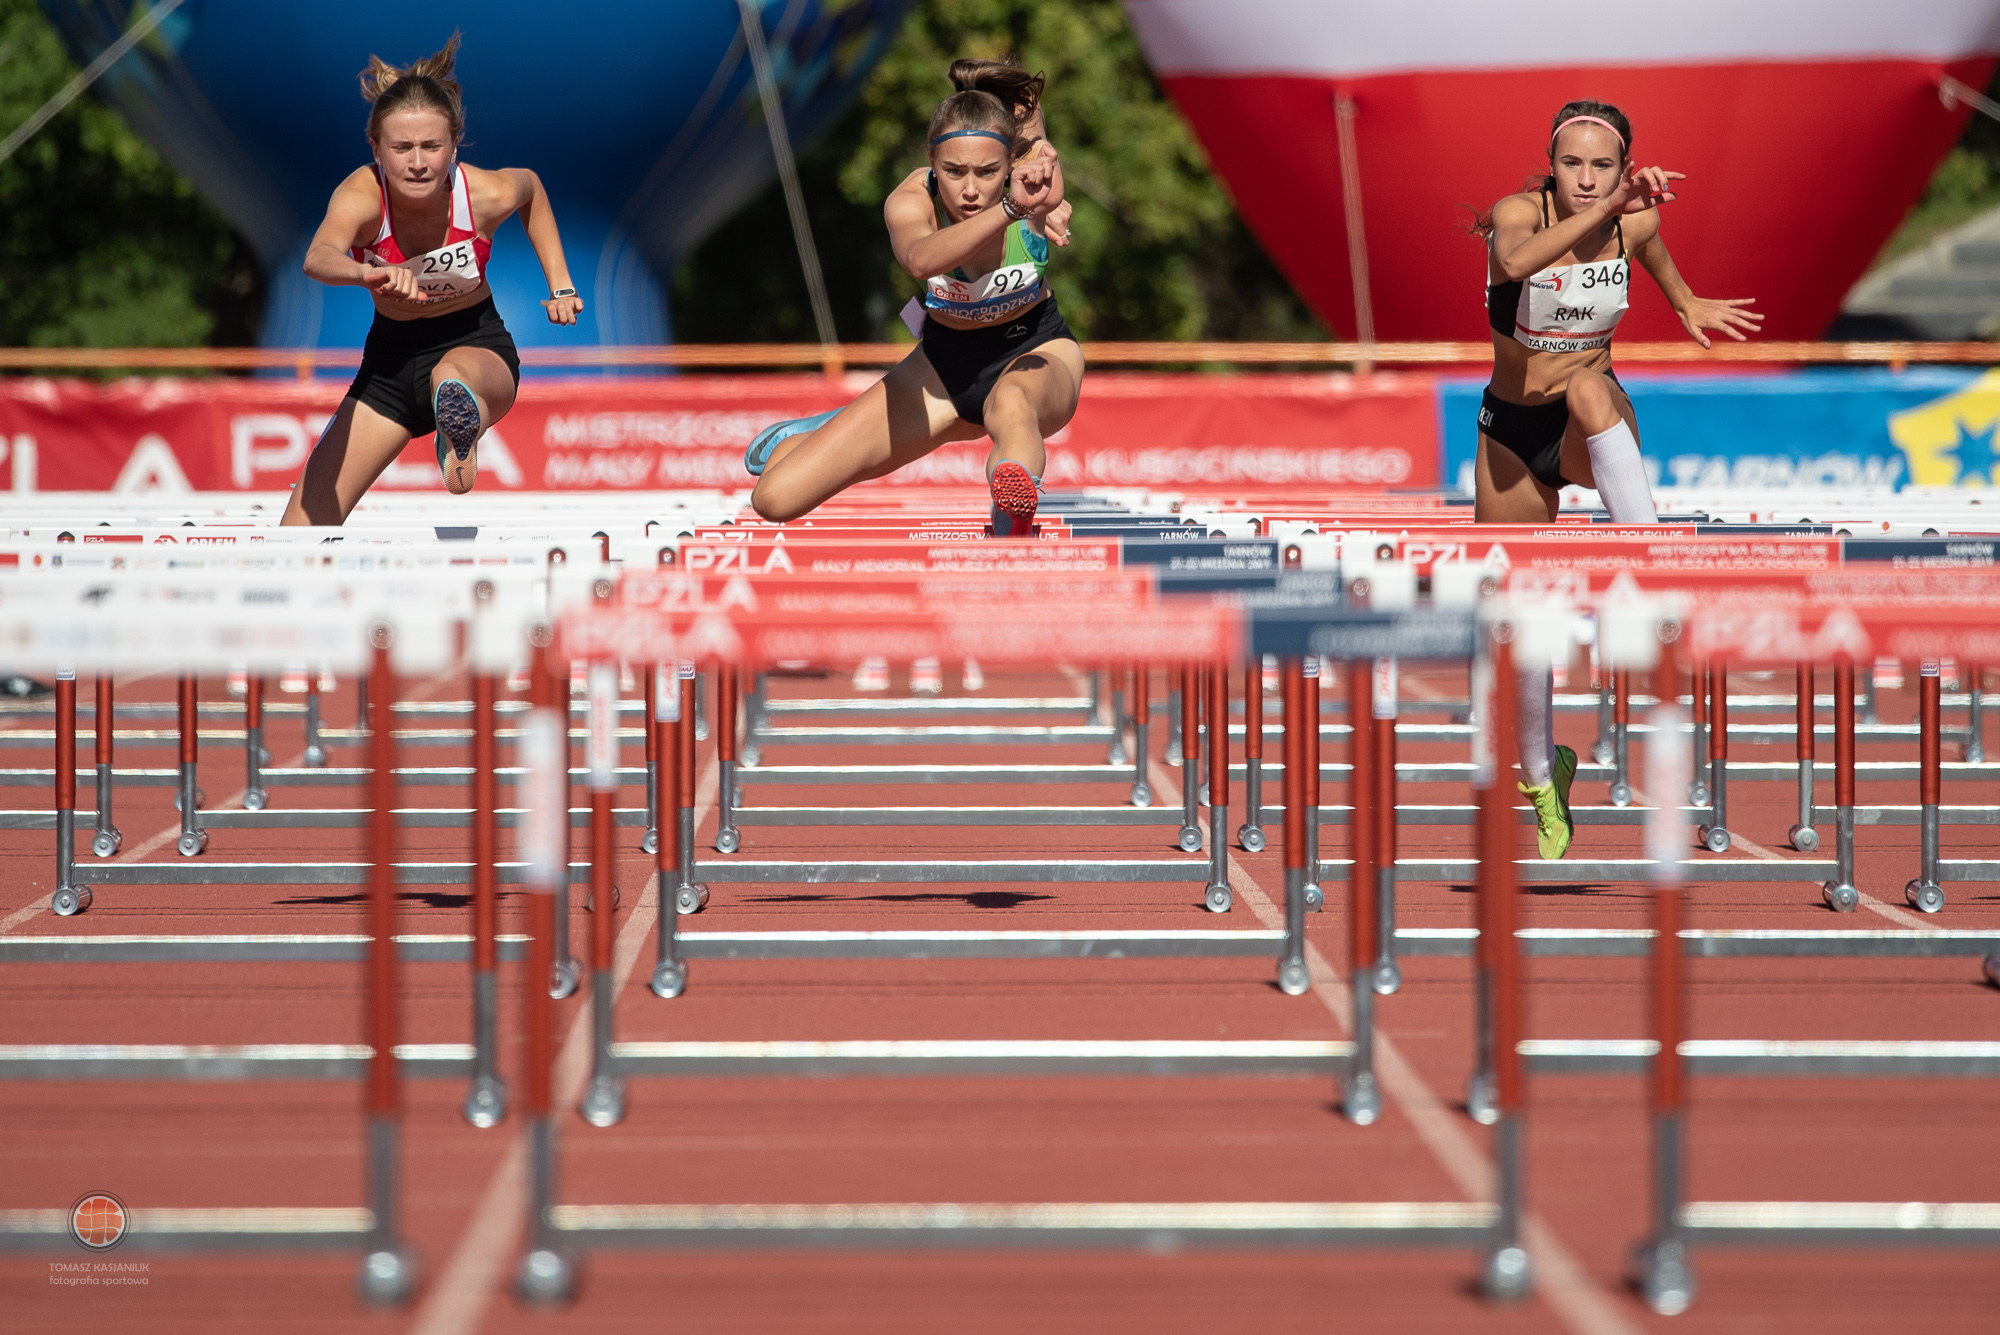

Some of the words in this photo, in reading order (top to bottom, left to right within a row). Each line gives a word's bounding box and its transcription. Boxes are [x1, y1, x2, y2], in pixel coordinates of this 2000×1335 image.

[422, 245, 470, 274] 295
[994, 269, 1025, 294] 92
[1582, 263, 1624, 289] 346
[937, 289, 969, 302] ORLEN
[1554, 305, 1595, 321] RAK
[1528, 338, 1579, 351] TARNÓW
[1581, 338, 1605, 350] 2019
[1039, 532, 1060, 542] U16
[1159, 527, 1200, 541] TARNÓW
[1533, 530, 1616, 540] MISTRZOSTWA
[1663, 530, 1684, 540] U16
[684, 546, 795, 575] PZLA
[1403, 542, 1511, 570] PZLA
